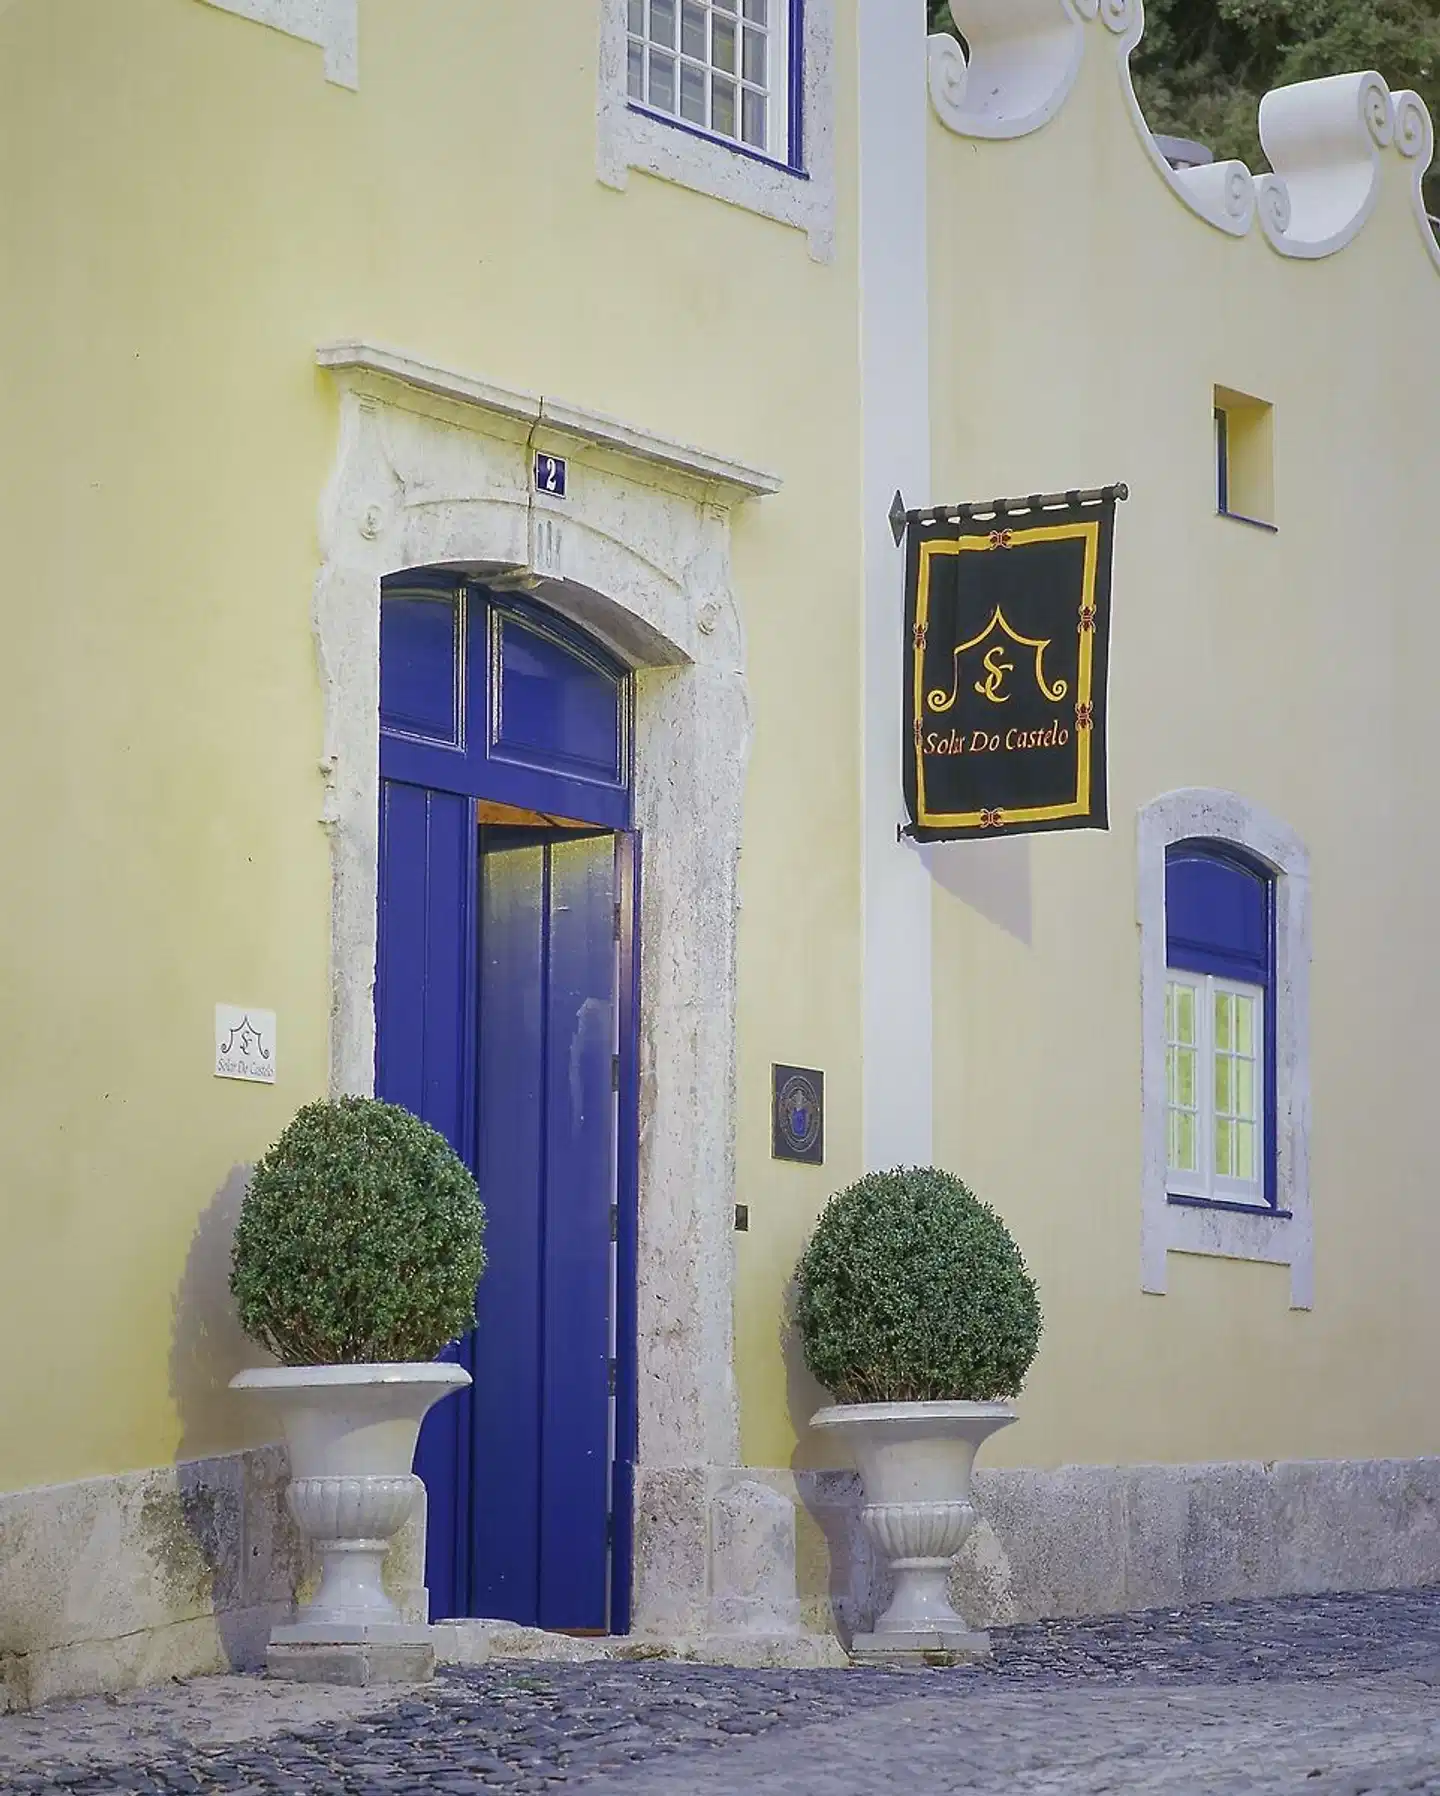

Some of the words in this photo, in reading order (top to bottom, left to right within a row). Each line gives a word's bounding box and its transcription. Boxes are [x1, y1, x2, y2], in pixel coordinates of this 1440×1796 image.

[546, 458, 556, 491] 2
[969, 730, 1000, 752] Do
[1005, 719, 1069, 750] Castelo
